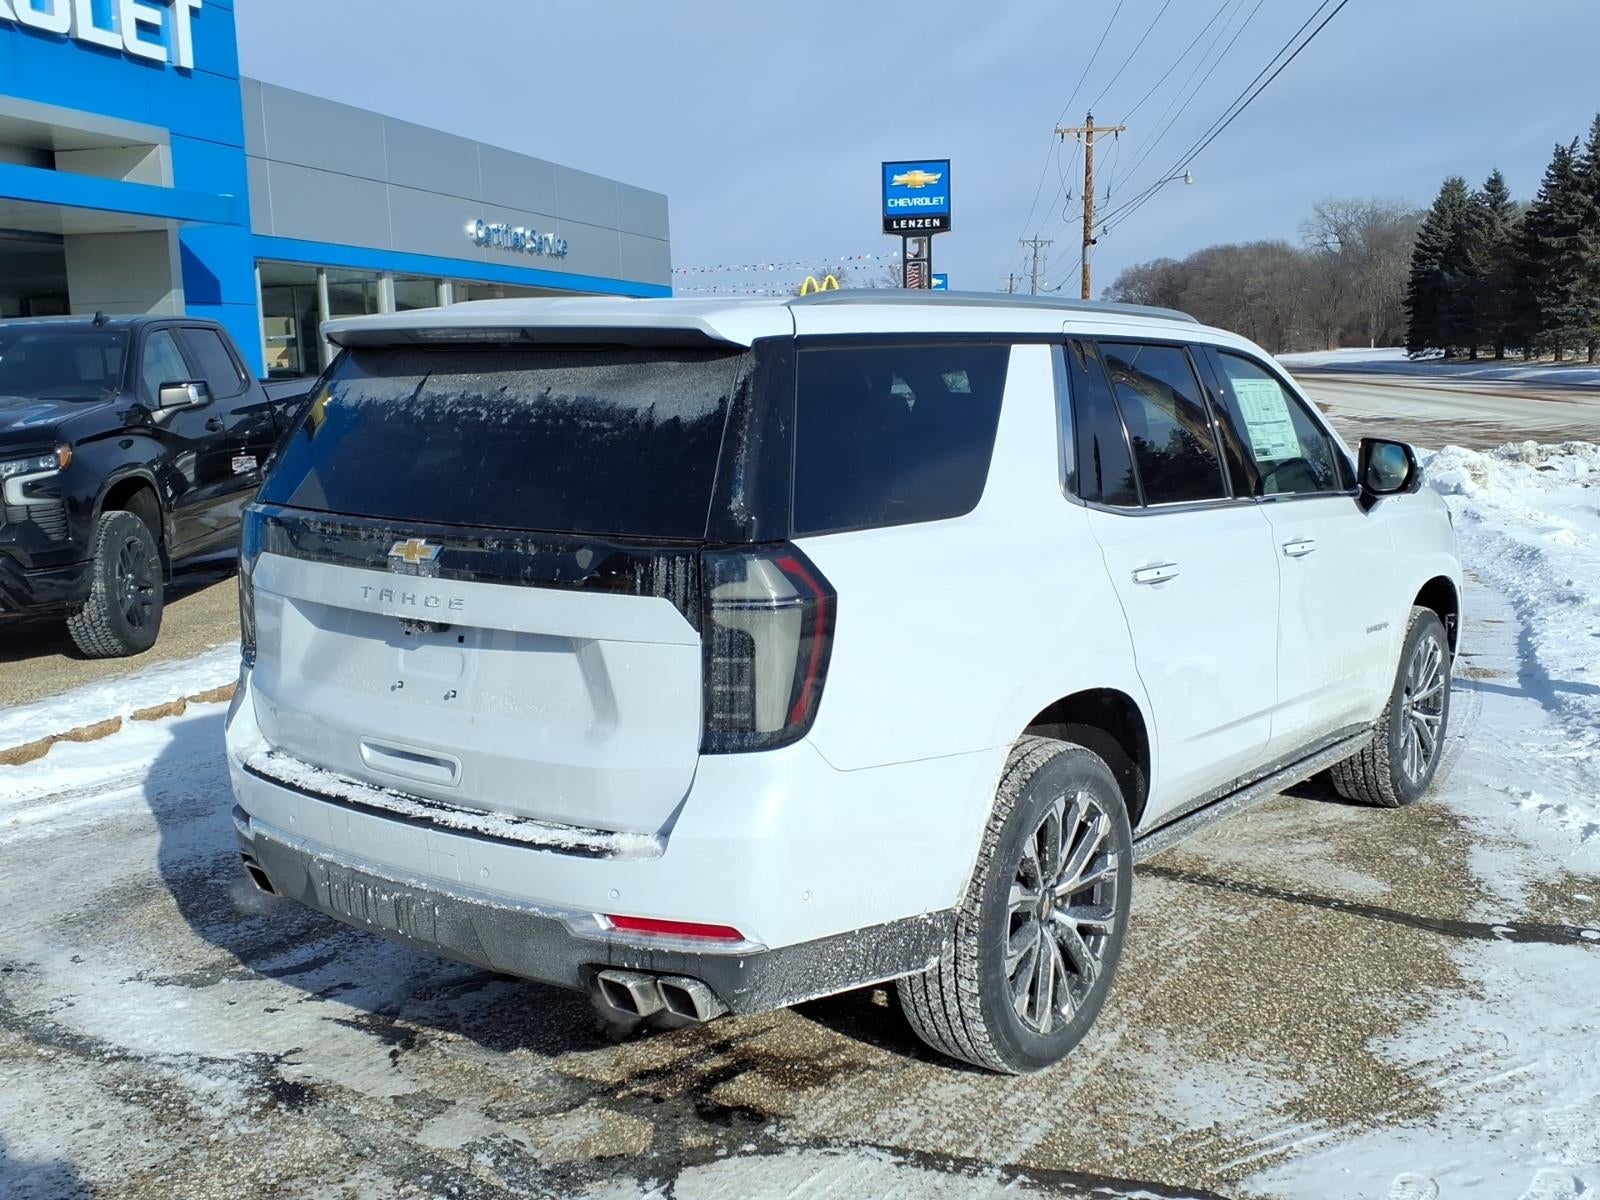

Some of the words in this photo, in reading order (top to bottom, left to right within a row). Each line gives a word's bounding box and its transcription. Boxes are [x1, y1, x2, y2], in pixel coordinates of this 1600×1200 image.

[0, 0, 202, 69] OLET
[888, 197, 944, 207] CHEVROLET
[894, 219, 940, 228] LENZEN
[475, 219, 527, 249] Certified
[528, 230, 568, 257] Service
[361, 586, 464, 610] TAHOE
